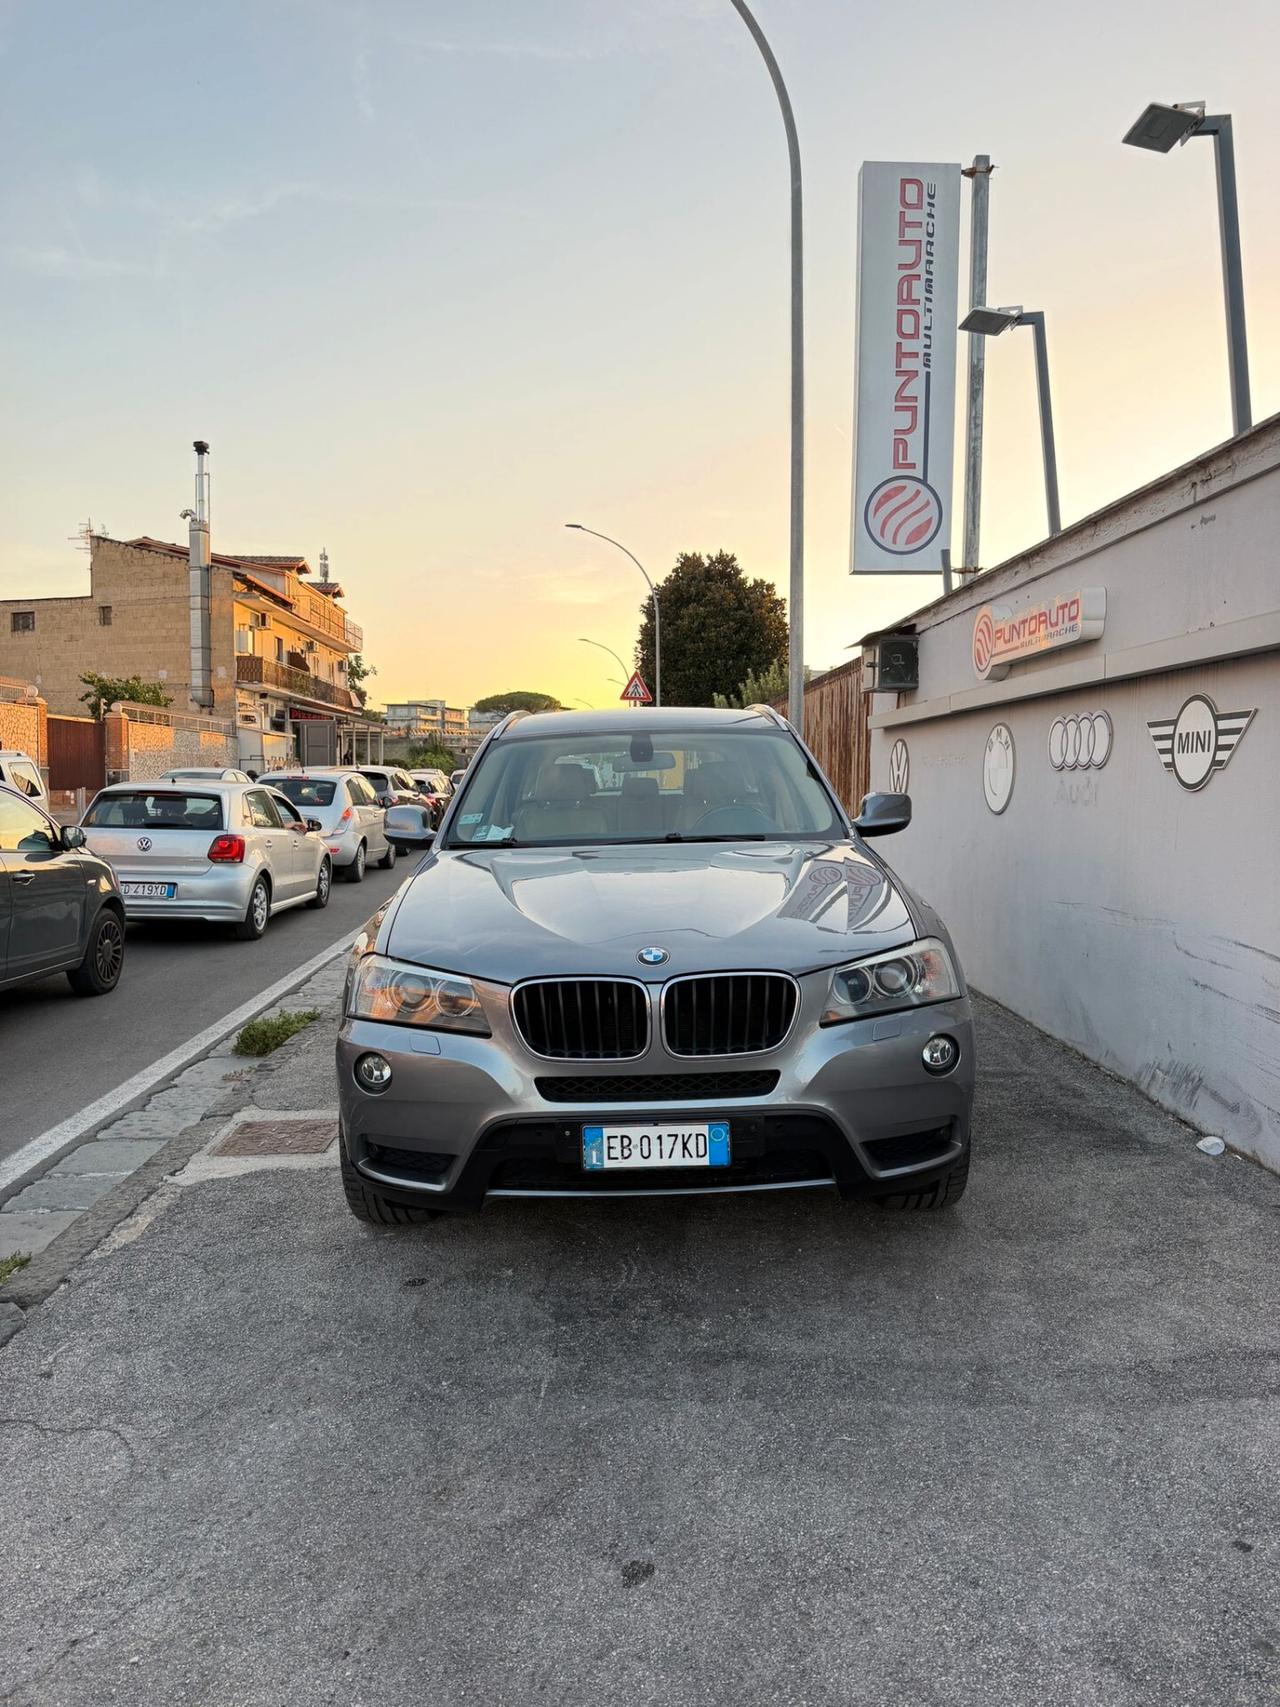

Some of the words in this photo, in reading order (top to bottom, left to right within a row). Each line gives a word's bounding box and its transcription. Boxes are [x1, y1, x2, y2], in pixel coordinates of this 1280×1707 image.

[893, 178, 924, 469] PUNTOAUTO
[922, 182, 937, 369] MULTIMARCHE
[994, 598, 1080, 648] PUNTOAUTO
[1177, 730, 1211, 754] MINI
